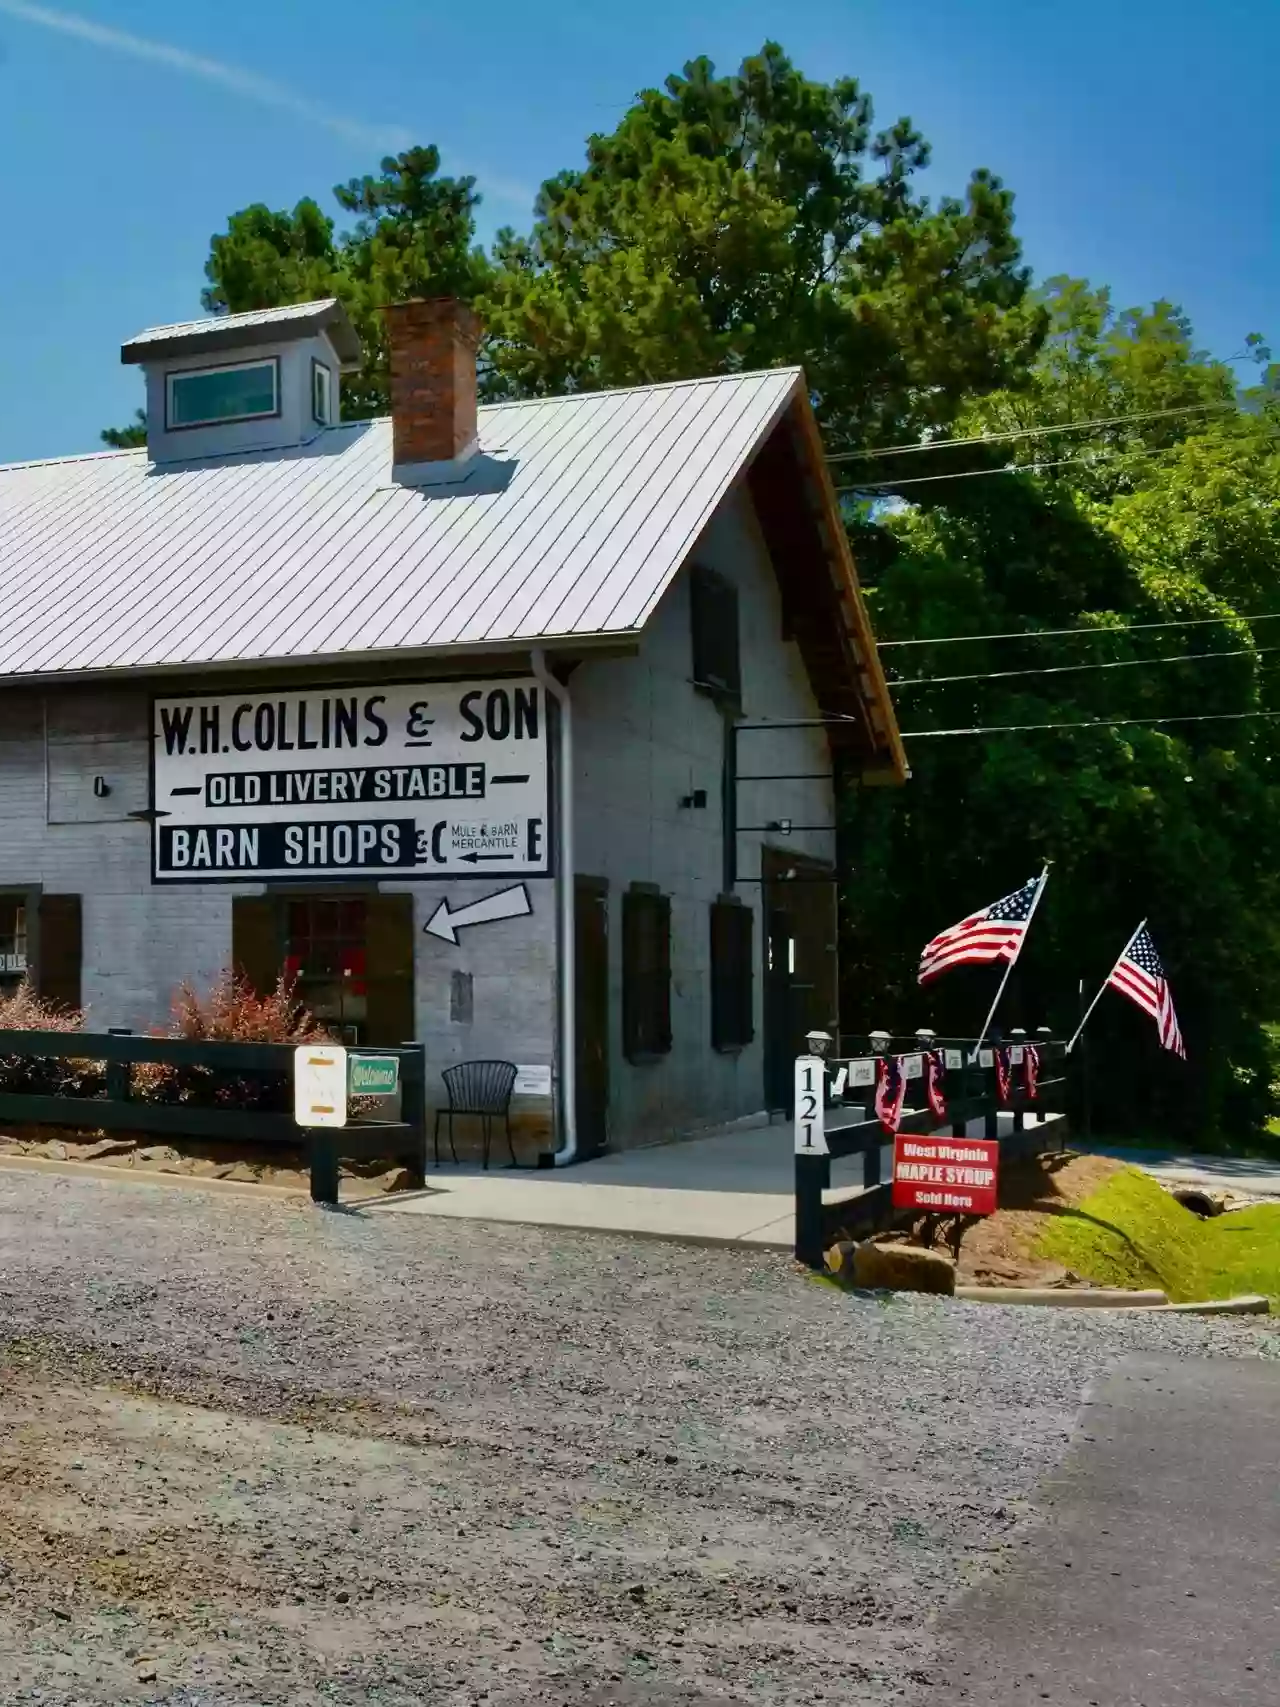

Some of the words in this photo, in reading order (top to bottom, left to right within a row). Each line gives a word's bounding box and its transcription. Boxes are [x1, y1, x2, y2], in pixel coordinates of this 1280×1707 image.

[404, 701, 435, 747] &
[459, 686, 539, 742] SON
[210, 775, 261, 804] OLD
[270, 770, 366, 801] LIVERY
[373, 766, 483, 798] STABLE
[452, 824, 477, 837] MULE
[491, 823, 518, 837] BARN
[171, 828, 259, 867] BARN
[284, 824, 401, 865] SHOPS
[452, 836, 519, 849] MERCANTILE
[799, 1066, 818, 1148] 121
[903, 1143, 937, 1158] West
[937, 1146, 989, 1162] Virginia
[896, 1163, 943, 1182] MAPLE
[945, 1167, 995, 1186] SYRUP
[915, 1191, 942, 1205] Sold
[944, 1193, 973, 1208] Here
